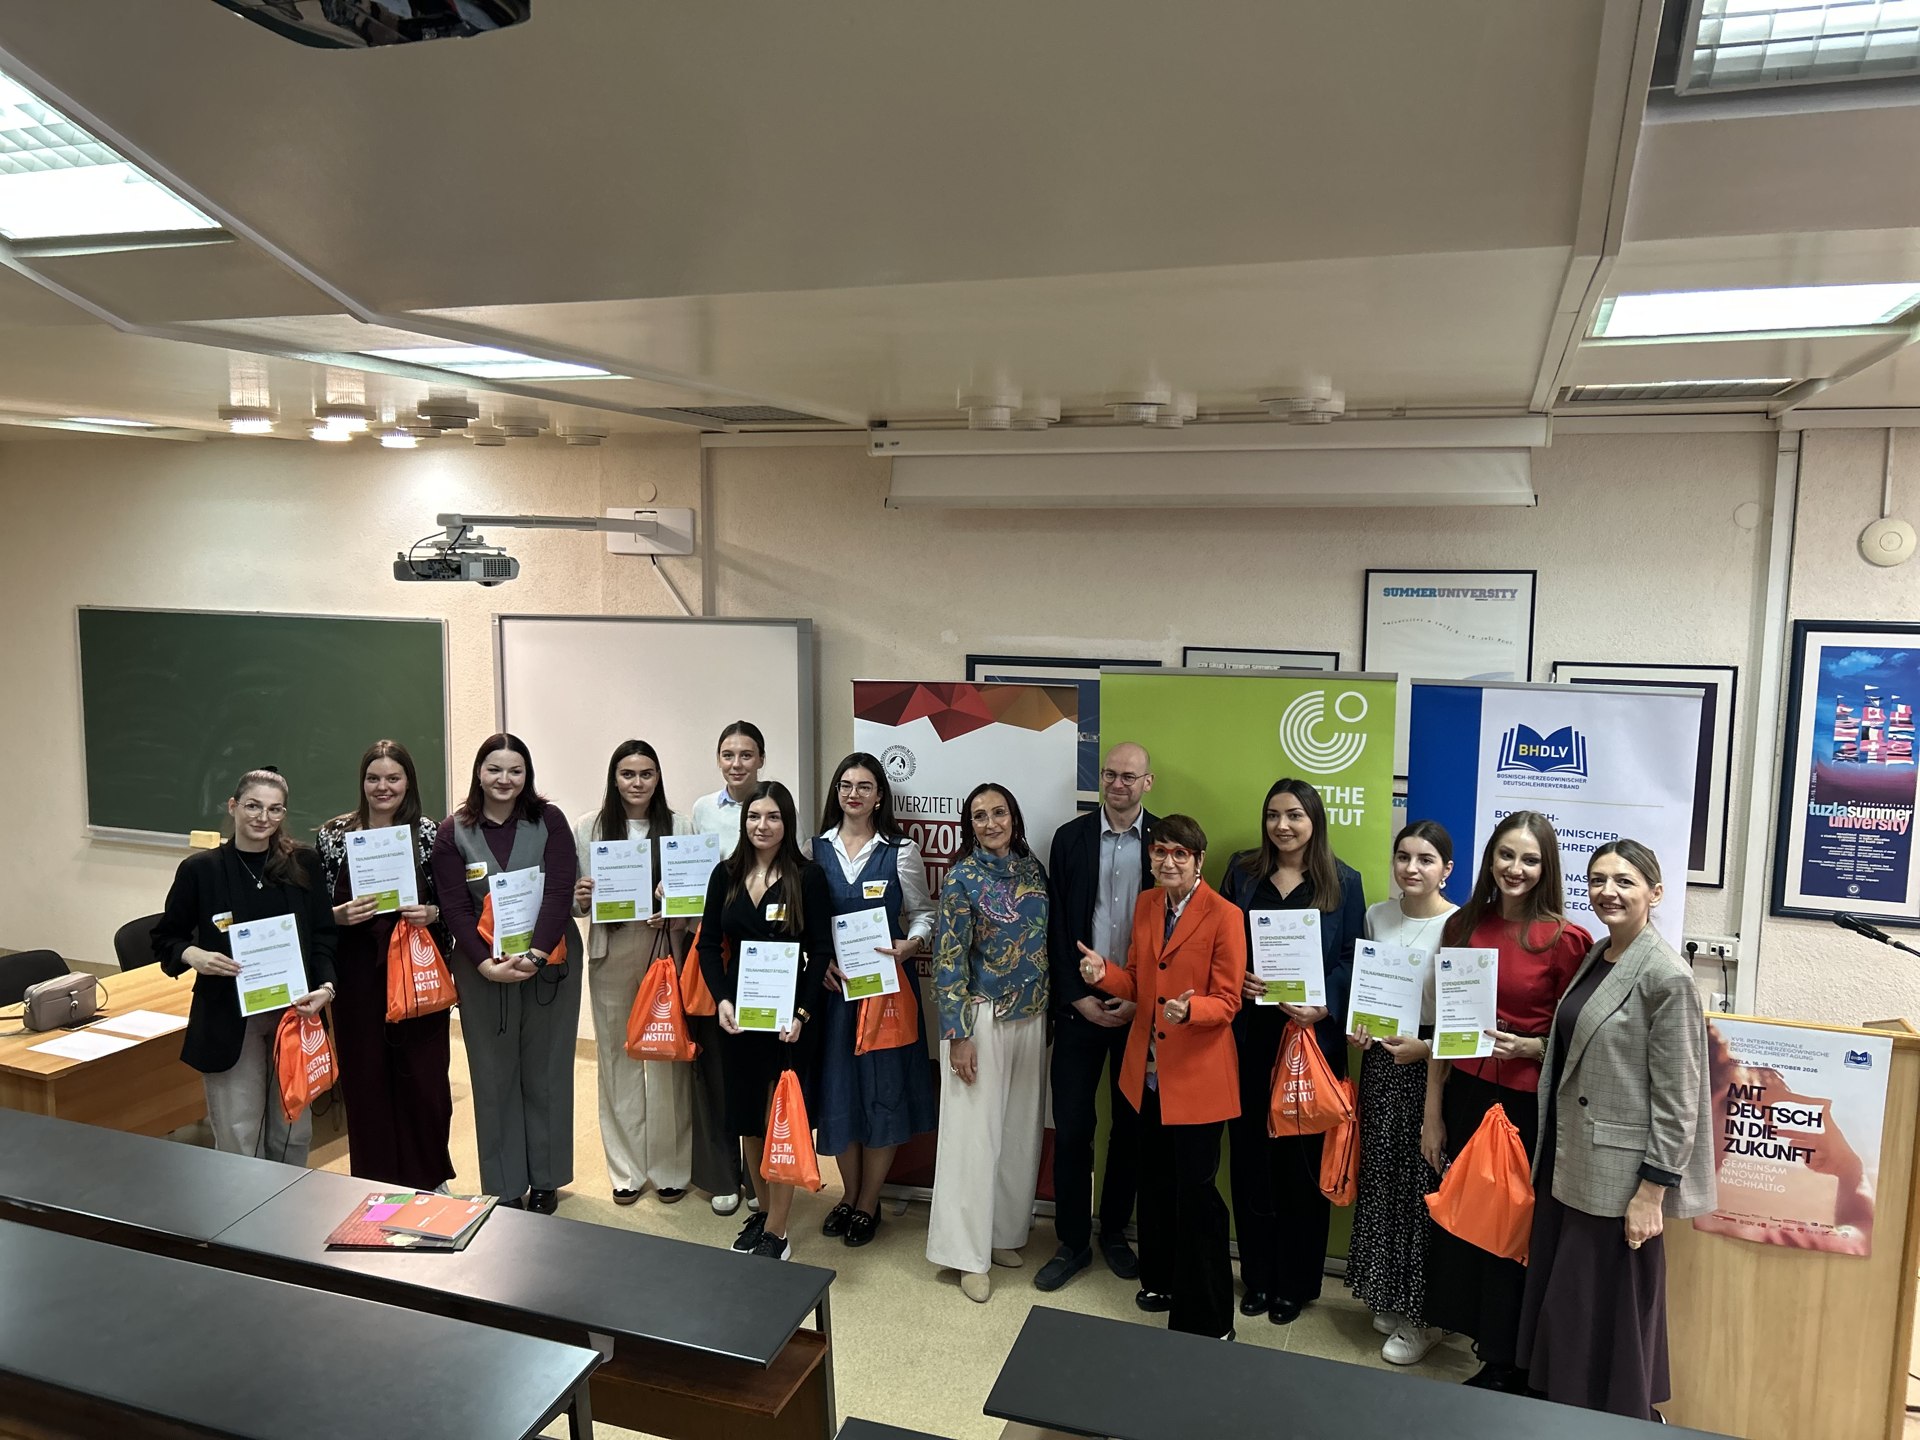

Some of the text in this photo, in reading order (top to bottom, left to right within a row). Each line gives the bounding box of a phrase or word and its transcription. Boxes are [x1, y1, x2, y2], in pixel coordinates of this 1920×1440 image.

[1519, 744, 1568, 758] BHDLV
[1503, 780, 1580, 790] DEUTSCHLEHRERVERBAND
[1313, 785, 1365, 805] THE
[893, 795, 953, 814] IVERZITET
[1828, 816, 1909, 836] university
[1555, 828, 1619, 841] WINISCHER
[1565, 874, 1589, 883] NAS
[1567, 888, 1588, 897] JEZ
[645, 1022, 675, 1032] GOETH
[642, 1032, 677, 1042] INSTITU
[1746, 1038, 1803, 1049] INTERNATIONALE
[1771, 1064, 1802, 1072] OKTOBER
[1727, 1083, 1767, 1101] MIT
[1726, 1101, 1823, 1128] DEUTSCH
[1725, 1118, 1779, 1141] IN DIE
[1723, 1137, 1816, 1164] ZUKUNFT
[1721, 1158, 1787, 1176] GEMEINSAM
[1721, 1167, 1777, 1183] INNOVATIV
[1720, 1176, 1786, 1194] NACHHALTIG
